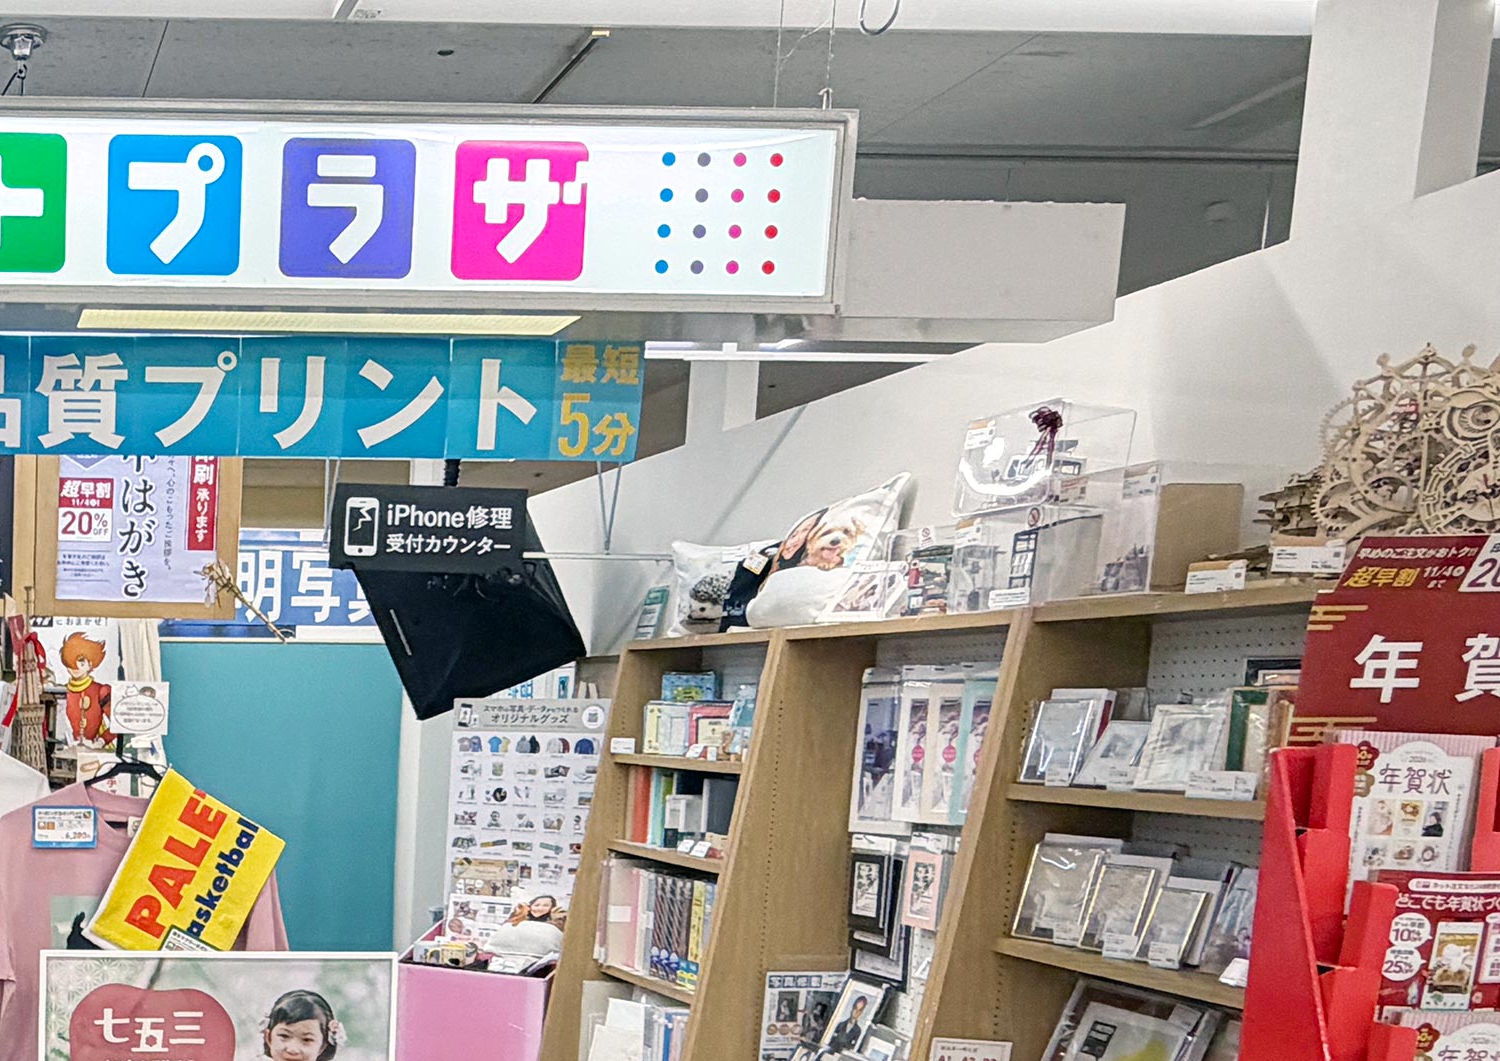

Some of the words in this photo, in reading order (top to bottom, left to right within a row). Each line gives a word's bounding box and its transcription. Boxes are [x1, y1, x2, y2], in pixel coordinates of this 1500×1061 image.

[558, 342, 640, 387] 最短
[558, 393, 639, 463] 5分
[60, 480, 112, 499] 超早割
[61, 510, 109, 536] 20%
[194, 487, 211, 543] 承ります
[386, 503, 514, 531] iPhone修理
[385, 533, 512, 555] 受付カウンター
[1342, 565, 1421, 588] 超早割
[491, 714, 570, 725] オリジナルグッズ
[1377, 762, 1454, 797] 年賀状
[124, 788, 228, 939] PALE
[93, 1006, 206, 1053] 七五三
